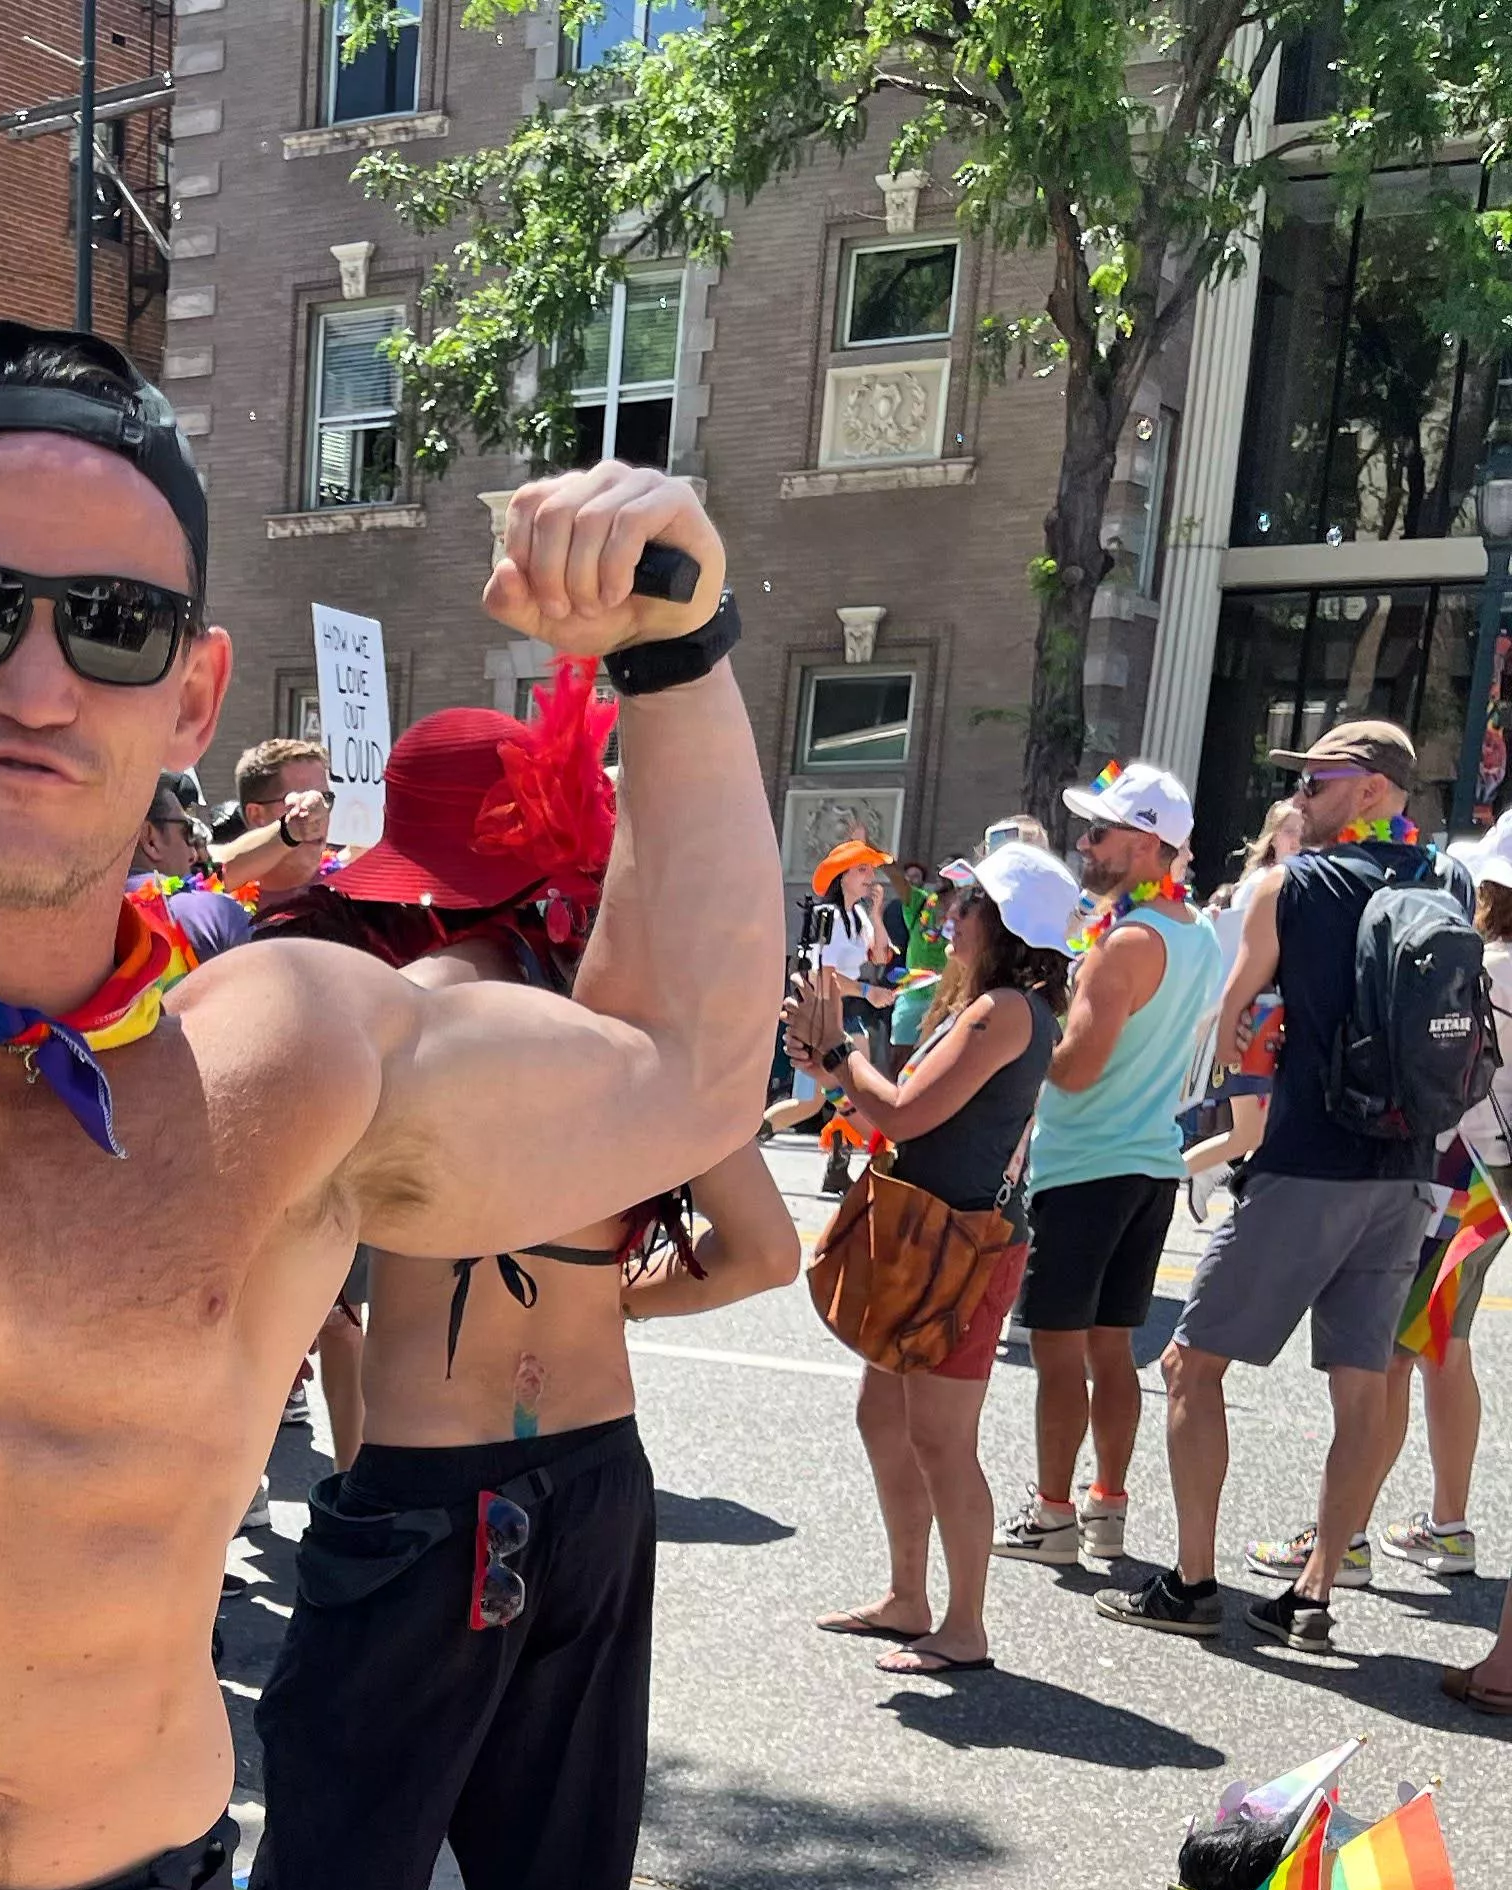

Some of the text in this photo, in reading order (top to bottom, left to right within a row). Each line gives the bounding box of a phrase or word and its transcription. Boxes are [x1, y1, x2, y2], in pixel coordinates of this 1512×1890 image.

[335, 663, 370, 698] LOVE
[343, 701, 367, 731] OUT
[327, 734, 385, 785] LOUD
